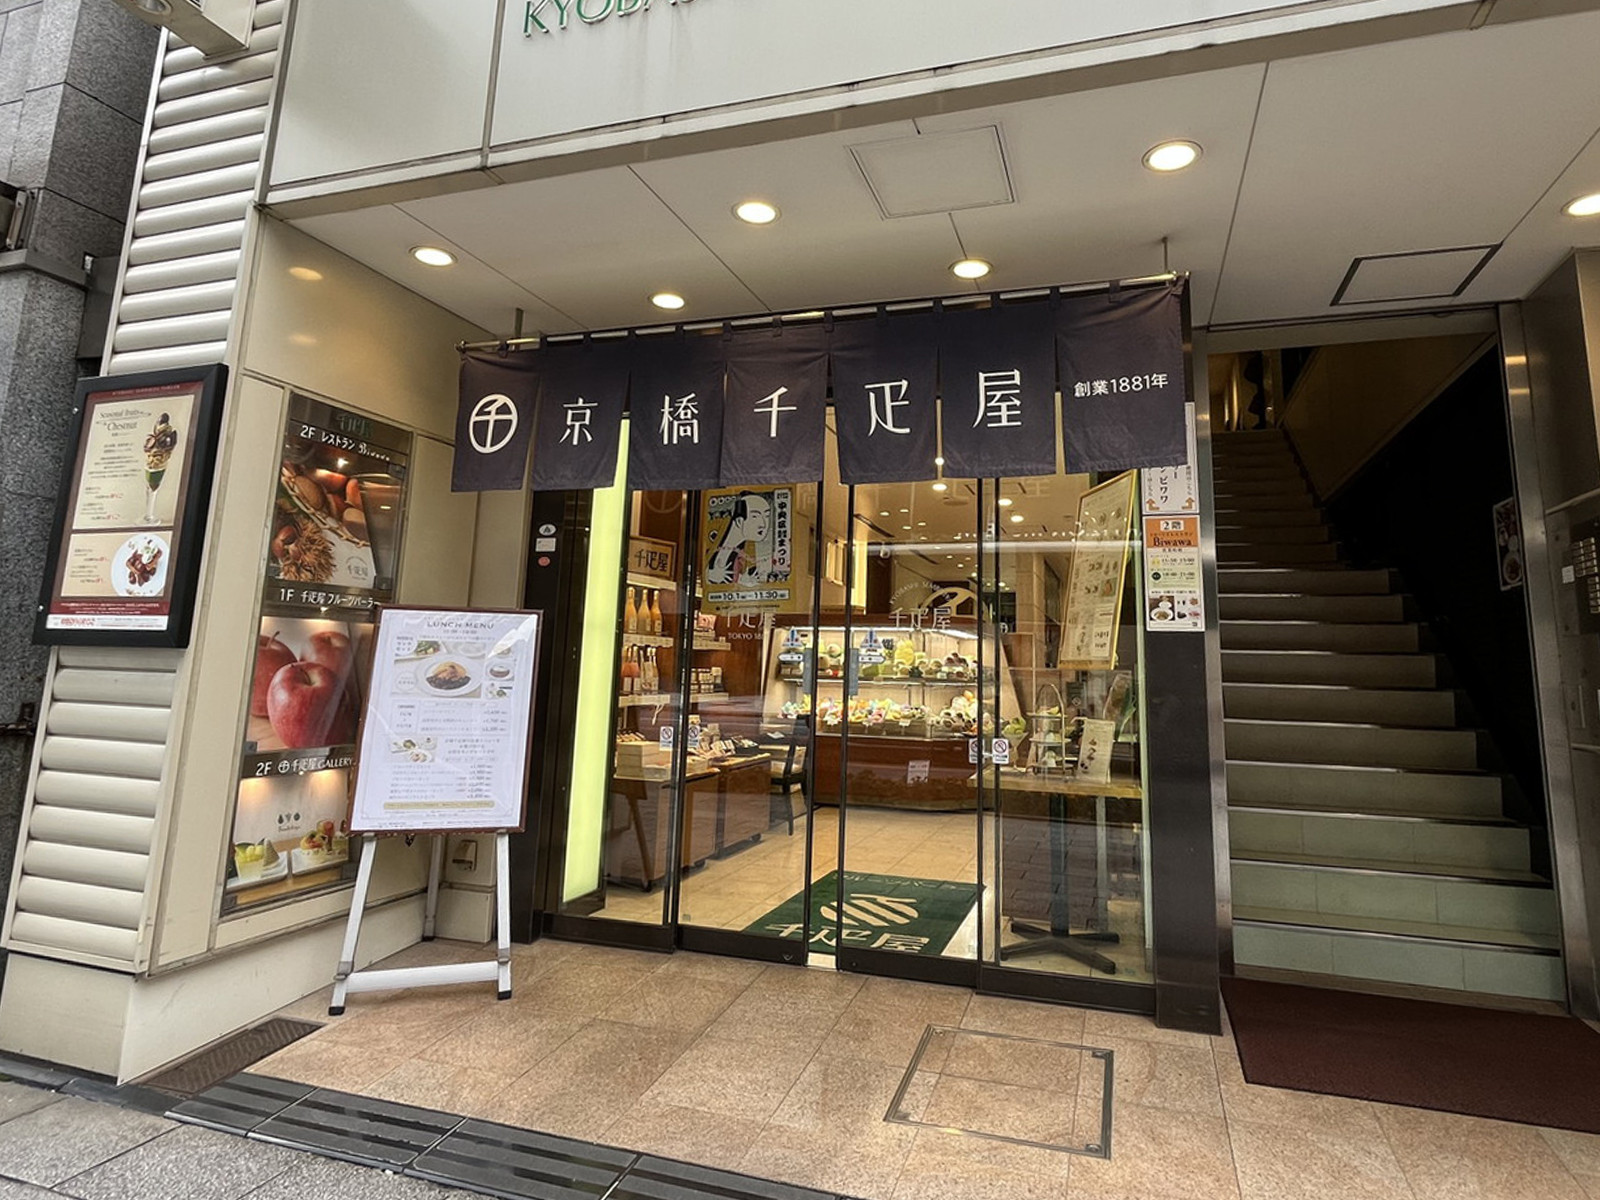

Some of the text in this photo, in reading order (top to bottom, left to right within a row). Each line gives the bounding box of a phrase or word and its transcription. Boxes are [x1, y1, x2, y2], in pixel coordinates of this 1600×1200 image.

[1073, 372, 1169, 398] 創業1881年
[300, 424, 316, 439] 2F
[321, 431, 356, 450] レストラン
[1153, 536, 1192, 547] Biwawa
[634, 548, 669, 572] 千疋屋
[280, 588, 295, 601] 1F
[427, 620, 494, 630] LUNCH MENU
[888, 607, 951, 630] 千疋屋
[727, 631, 753, 640] TOKYO
[255, 761, 273, 776] 2F
[764, 923, 931, 954] 千疋屋
